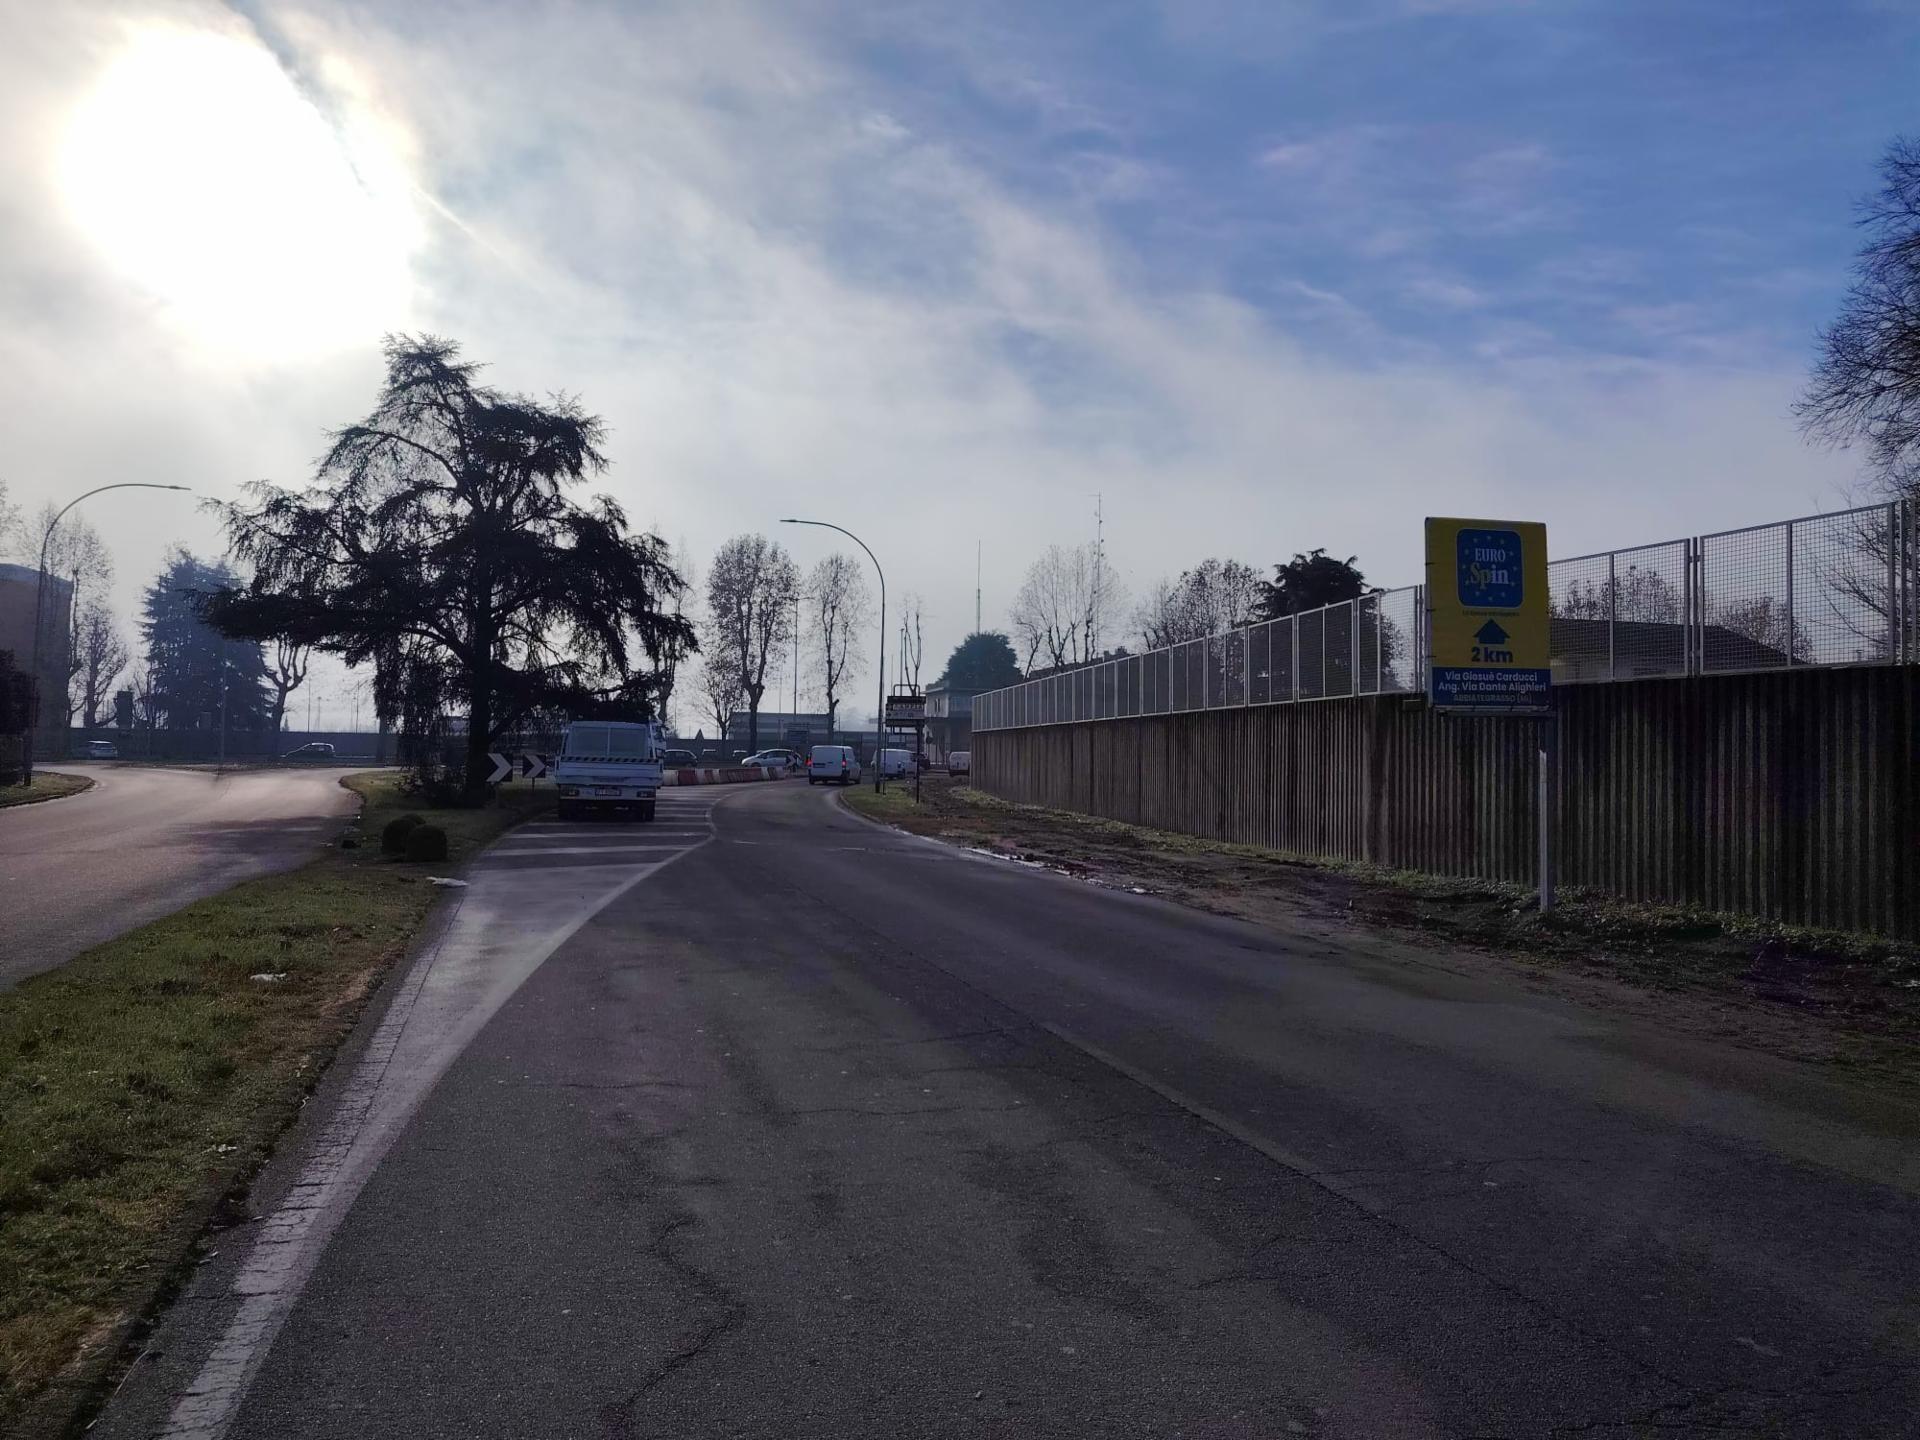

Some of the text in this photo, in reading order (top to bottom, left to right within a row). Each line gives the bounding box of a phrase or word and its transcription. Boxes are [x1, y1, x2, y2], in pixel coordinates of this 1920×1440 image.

[1475, 548, 1506, 562] EURO
[1470, 562, 1509, 590] Spin
[1471, 647, 1513, 663] 2 km
[1445, 671, 1461, 681] Via
[1496, 672, 1537, 681] Carducci
[1438, 682, 1546, 693] Ang. Via Dante Alighieri
